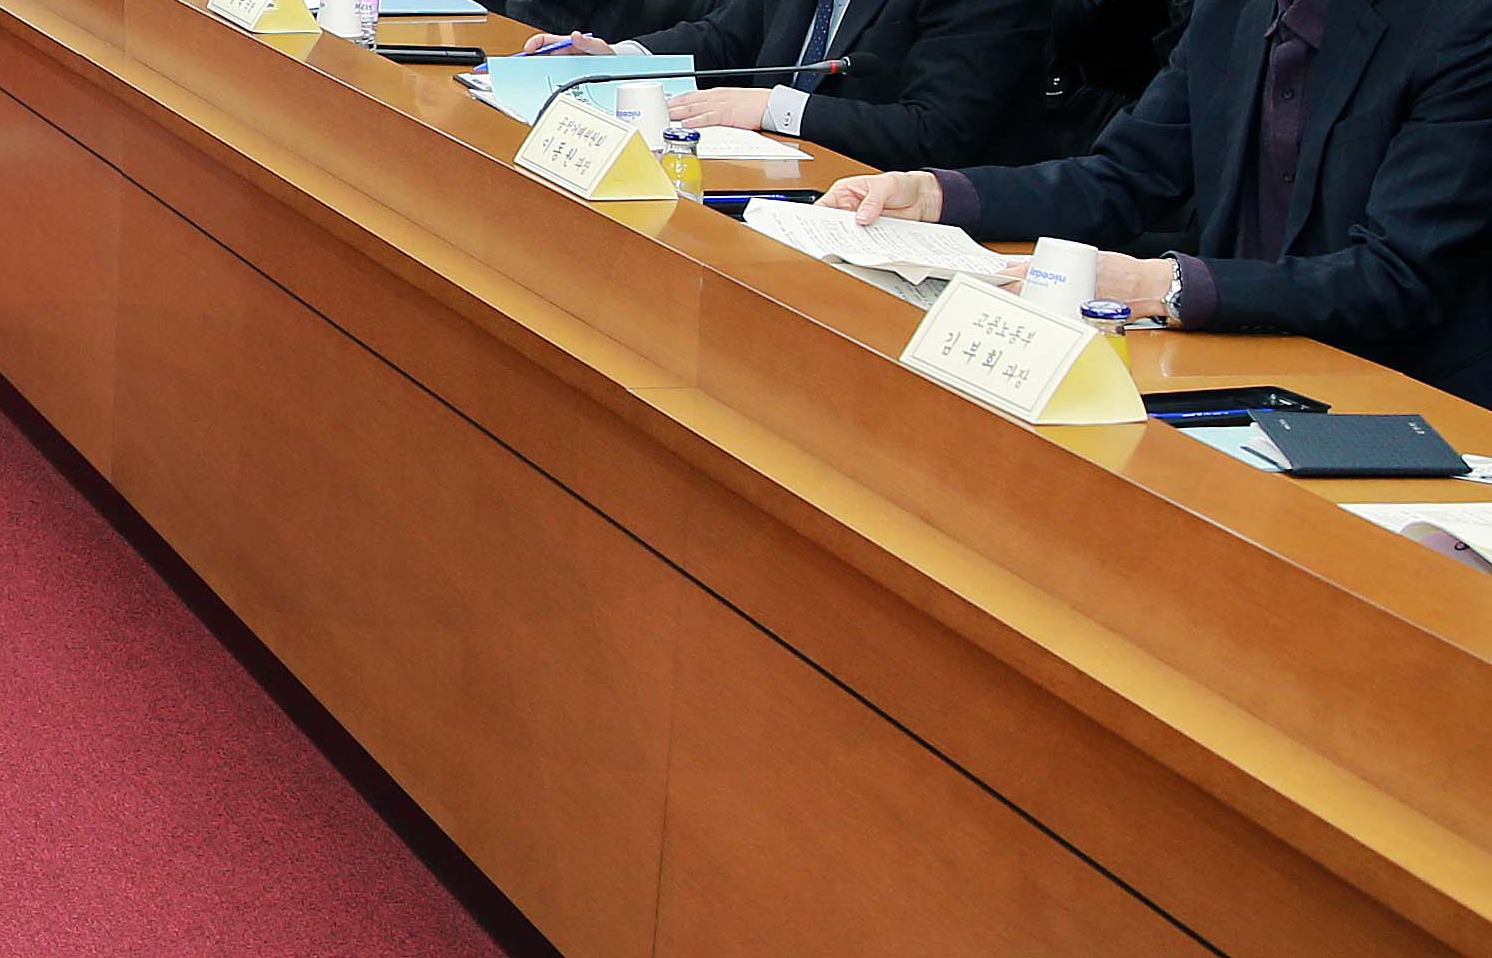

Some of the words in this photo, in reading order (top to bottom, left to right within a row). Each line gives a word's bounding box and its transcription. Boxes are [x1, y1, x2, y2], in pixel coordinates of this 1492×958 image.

[972, 313, 1036, 345] 고용노동부
[941, 331, 1003, 373] 김부희
[1002, 364, 1030, 389] 과장
